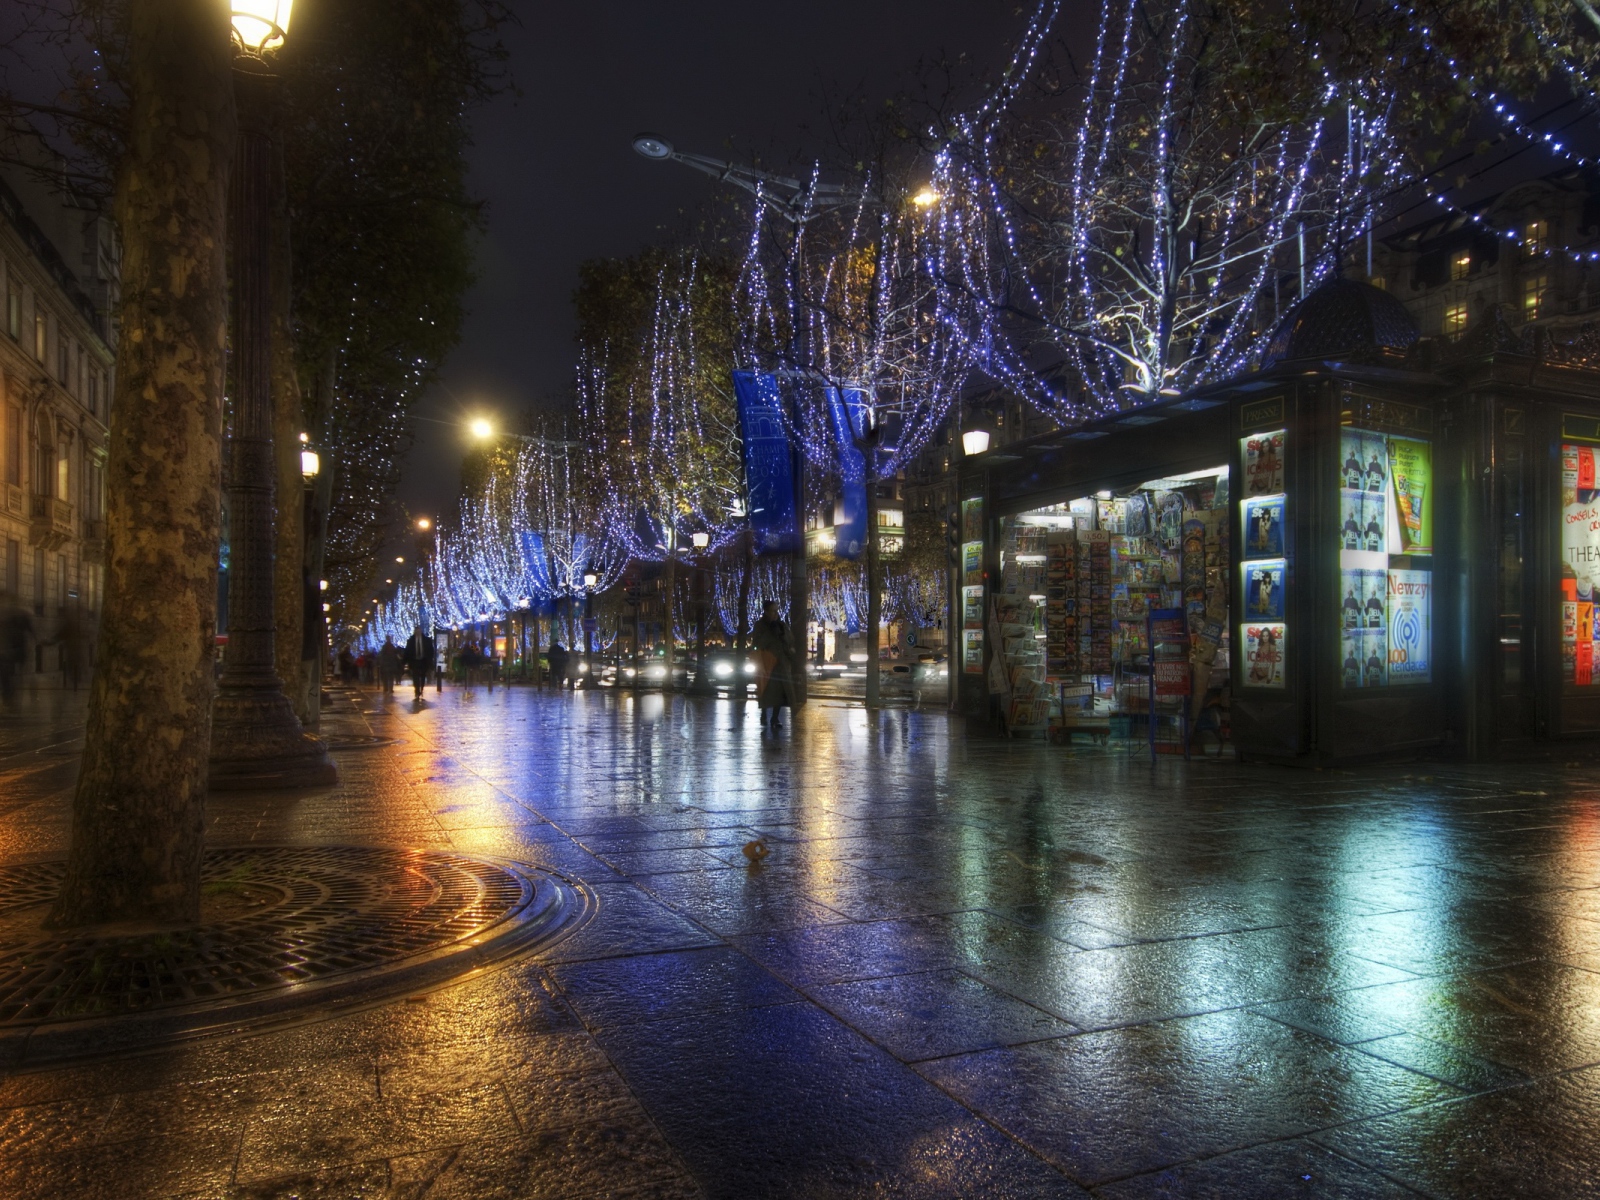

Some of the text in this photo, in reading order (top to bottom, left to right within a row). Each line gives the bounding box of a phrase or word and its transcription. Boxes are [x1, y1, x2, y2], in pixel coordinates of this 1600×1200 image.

[1247, 406, 1279, 422] PRESSE
[751, 465, 789, 477] 2008
[1387, 575, 1428, 599] Newzy
